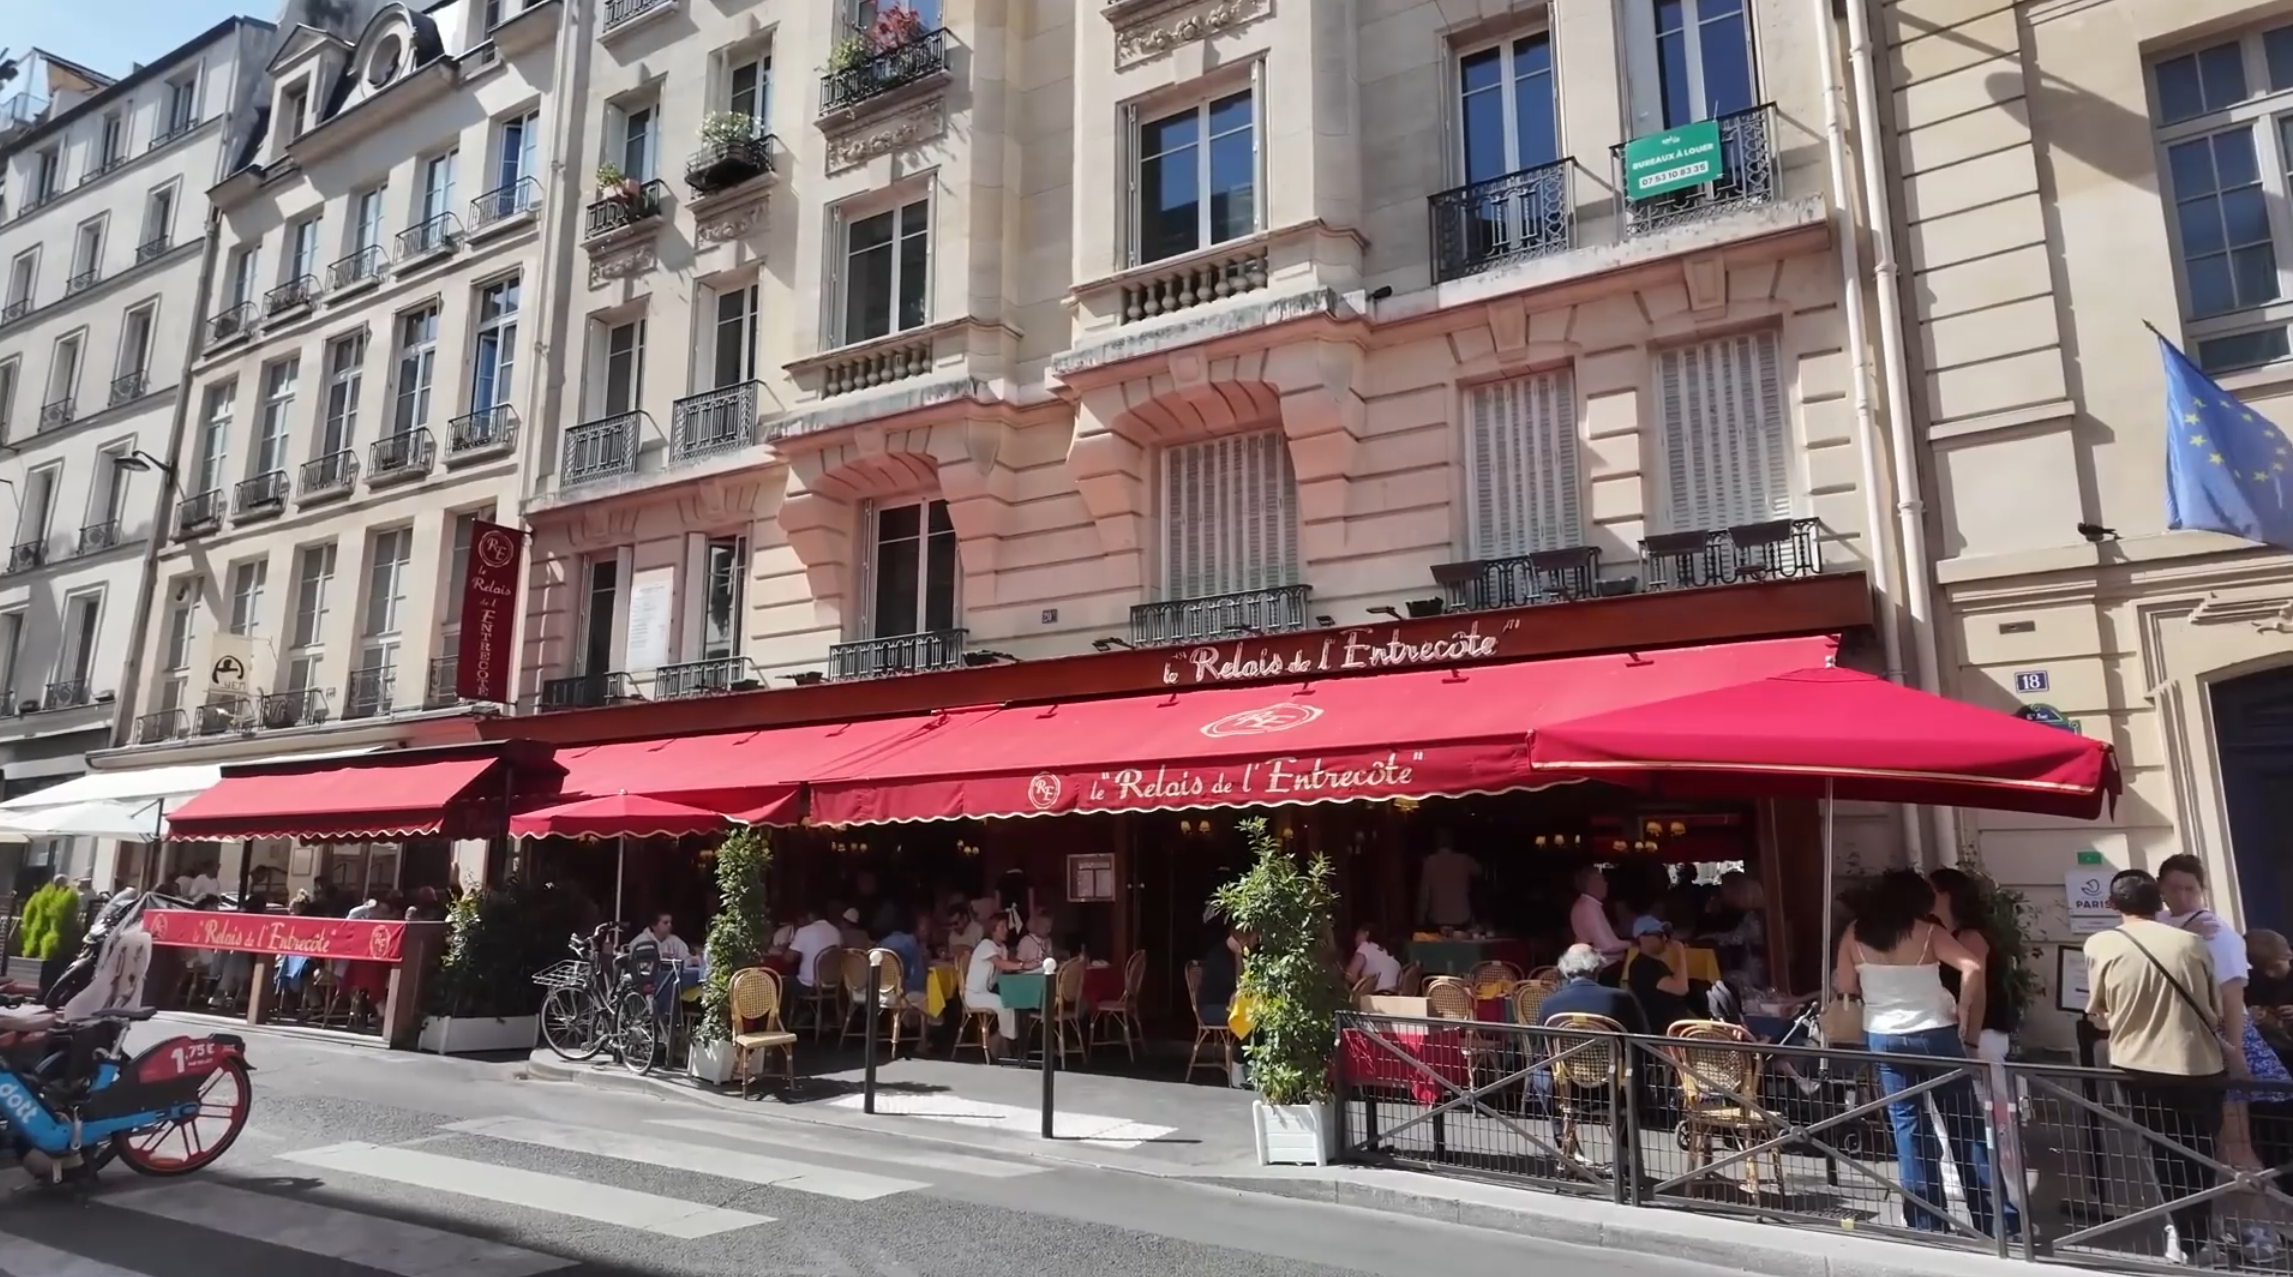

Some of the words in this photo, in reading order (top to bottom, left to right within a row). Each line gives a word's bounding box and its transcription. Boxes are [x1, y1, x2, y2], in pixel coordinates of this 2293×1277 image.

[1632, 153, 1675, 170] BUREAUX
[1684, 143, 1714, 156] LOUER
[1642, 178, 1653, 186] 07
[1655, 174, 1667, 182] 53
[1669, 170, 1678, 179] 10
[1680, 167, 1692, 176] 83
[1693, 164, 1706, 173] 35
[471, 577, 511, 596] Relais
[1285, 649, 1311, 673] de
[2022, 674, 2041, 690] 18
[1090, 781, 1105, 800] le
[1211, 772, 1232, 794] de
[2076, 900, 2112, 909] PARIS
[0, 1083, 38, 1124] dott
